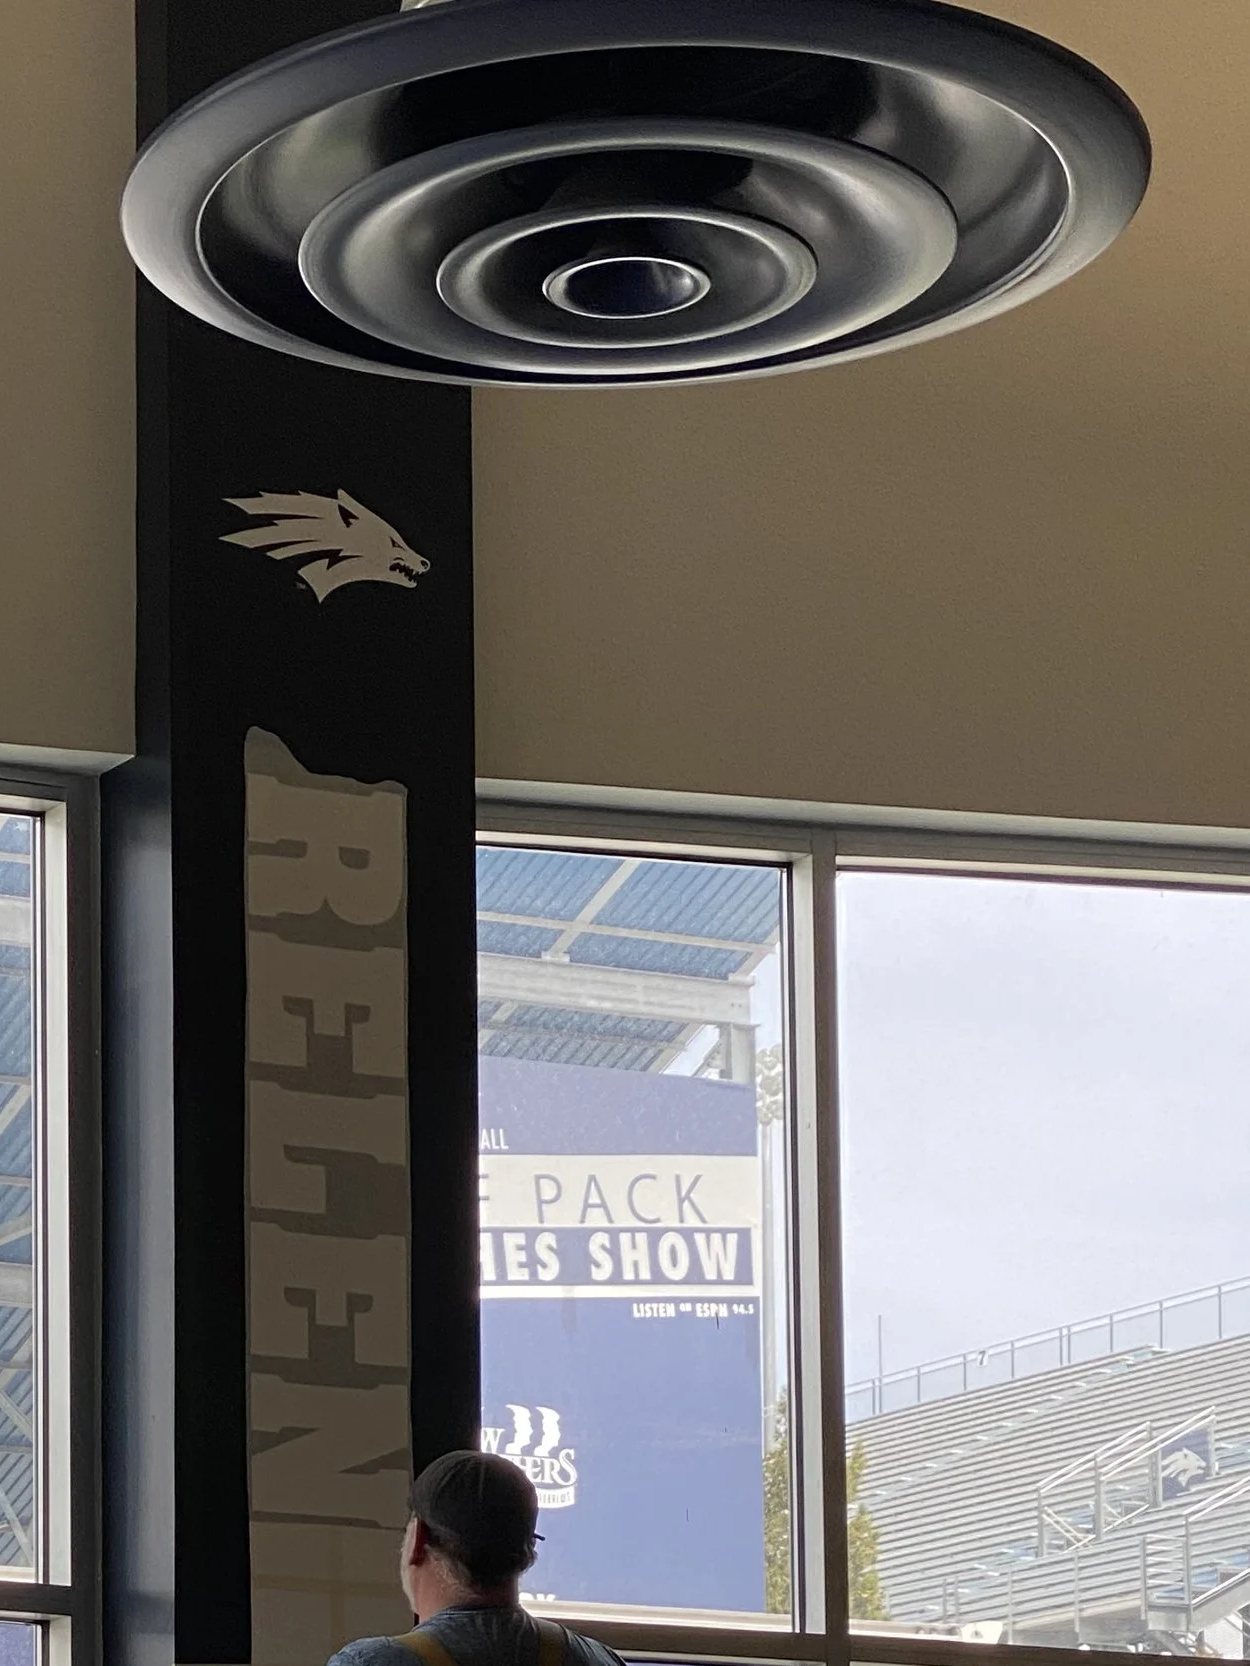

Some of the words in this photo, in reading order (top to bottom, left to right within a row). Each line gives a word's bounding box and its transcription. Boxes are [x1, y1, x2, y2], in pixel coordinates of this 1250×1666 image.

[534, 1173, 709, 1226] PACK
[588, 1231, 738, 1281] SHOW
[632, 1303, 676, 1318] LISTEN
[695, 1303, 728, 1317] ESPN
